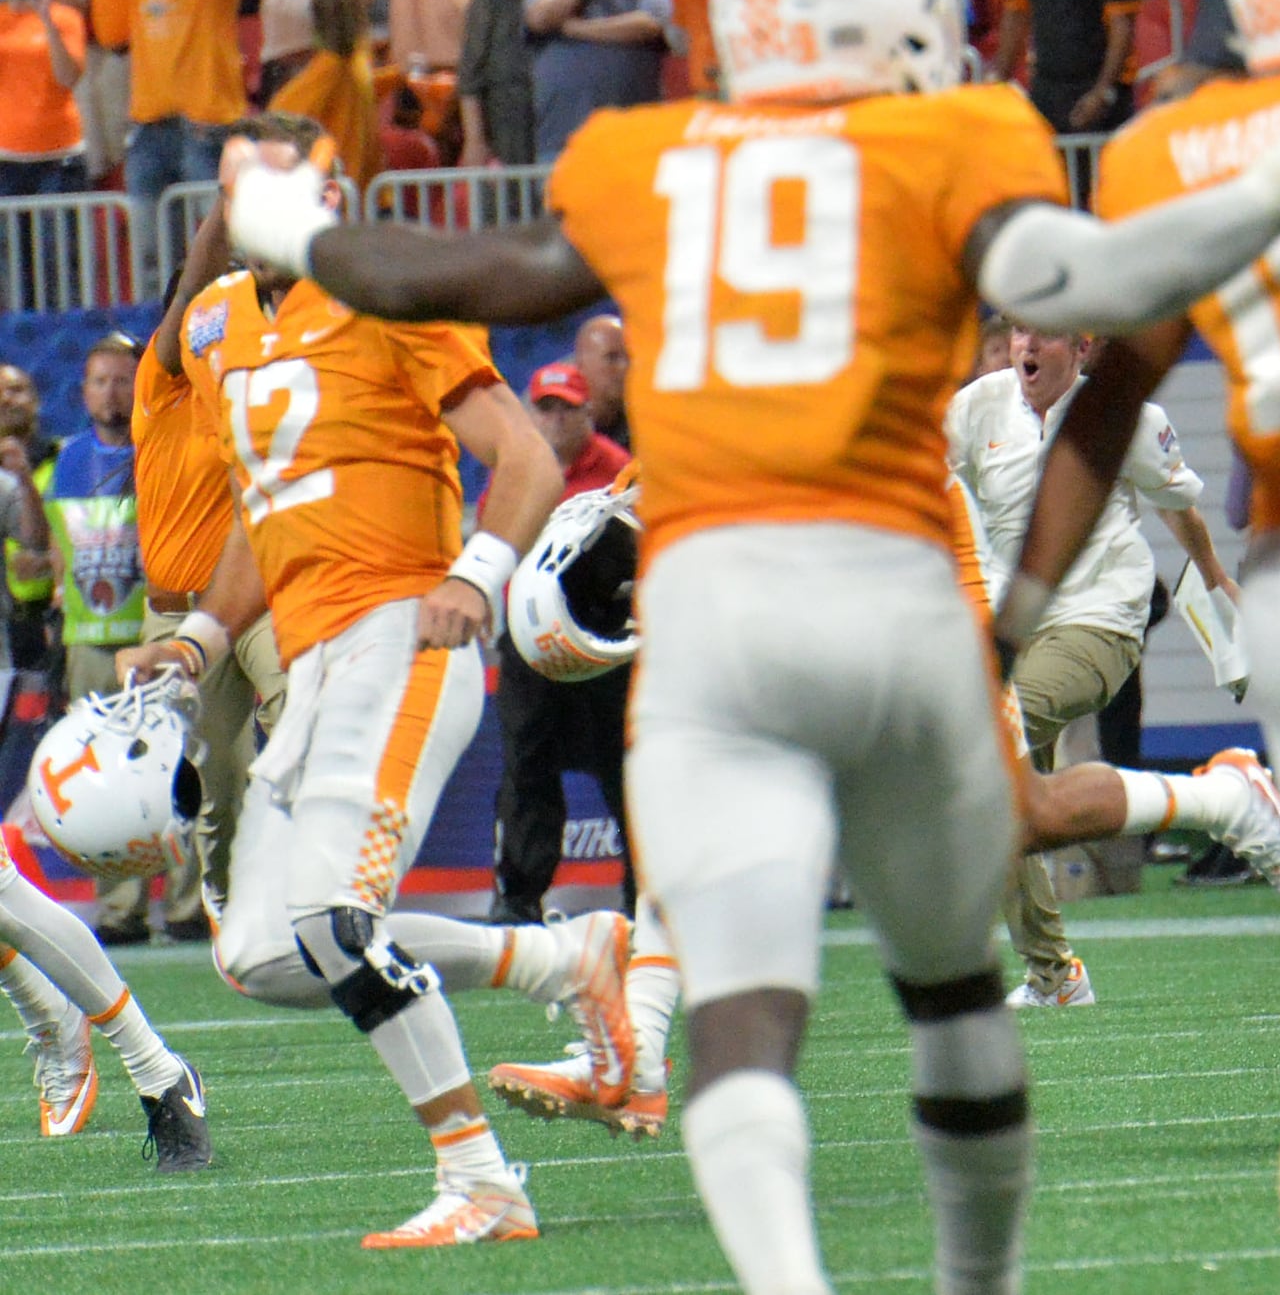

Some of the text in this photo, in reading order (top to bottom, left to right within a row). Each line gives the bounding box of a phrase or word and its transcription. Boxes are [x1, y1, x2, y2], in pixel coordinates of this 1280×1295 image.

[652, 135, 863, 392] 19
[260, 334, 280, 357] T
[223, 357, 336, 525] 12
[39, 743, 101, 817] T
